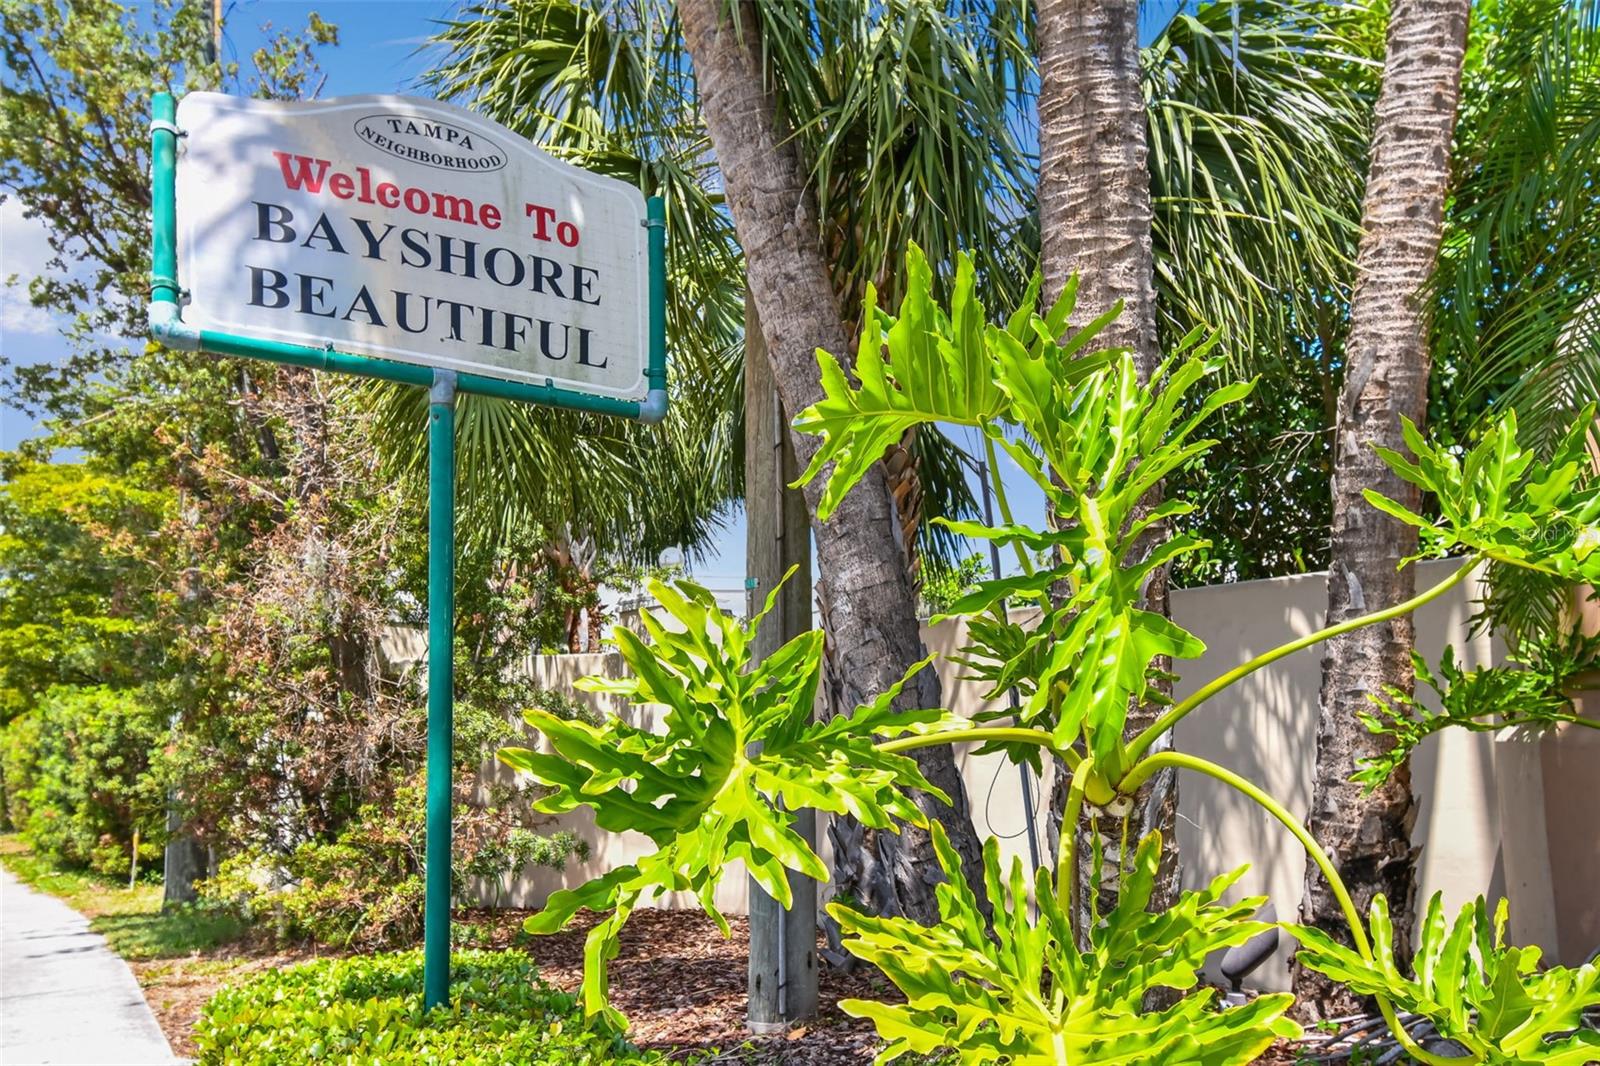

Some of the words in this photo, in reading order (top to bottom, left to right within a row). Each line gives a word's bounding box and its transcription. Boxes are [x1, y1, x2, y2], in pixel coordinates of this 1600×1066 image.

[361, 126, 501, 169] NEIGHBORHOOD
[387, 119, 474, 151] TAMPA
[274, 151, 501, 229] Welcome
[526, 204, 580, 248] To
[252, 201, 601, 306] BAYSHORE
[247, 265, 608, 369] BEAUTIFUL
